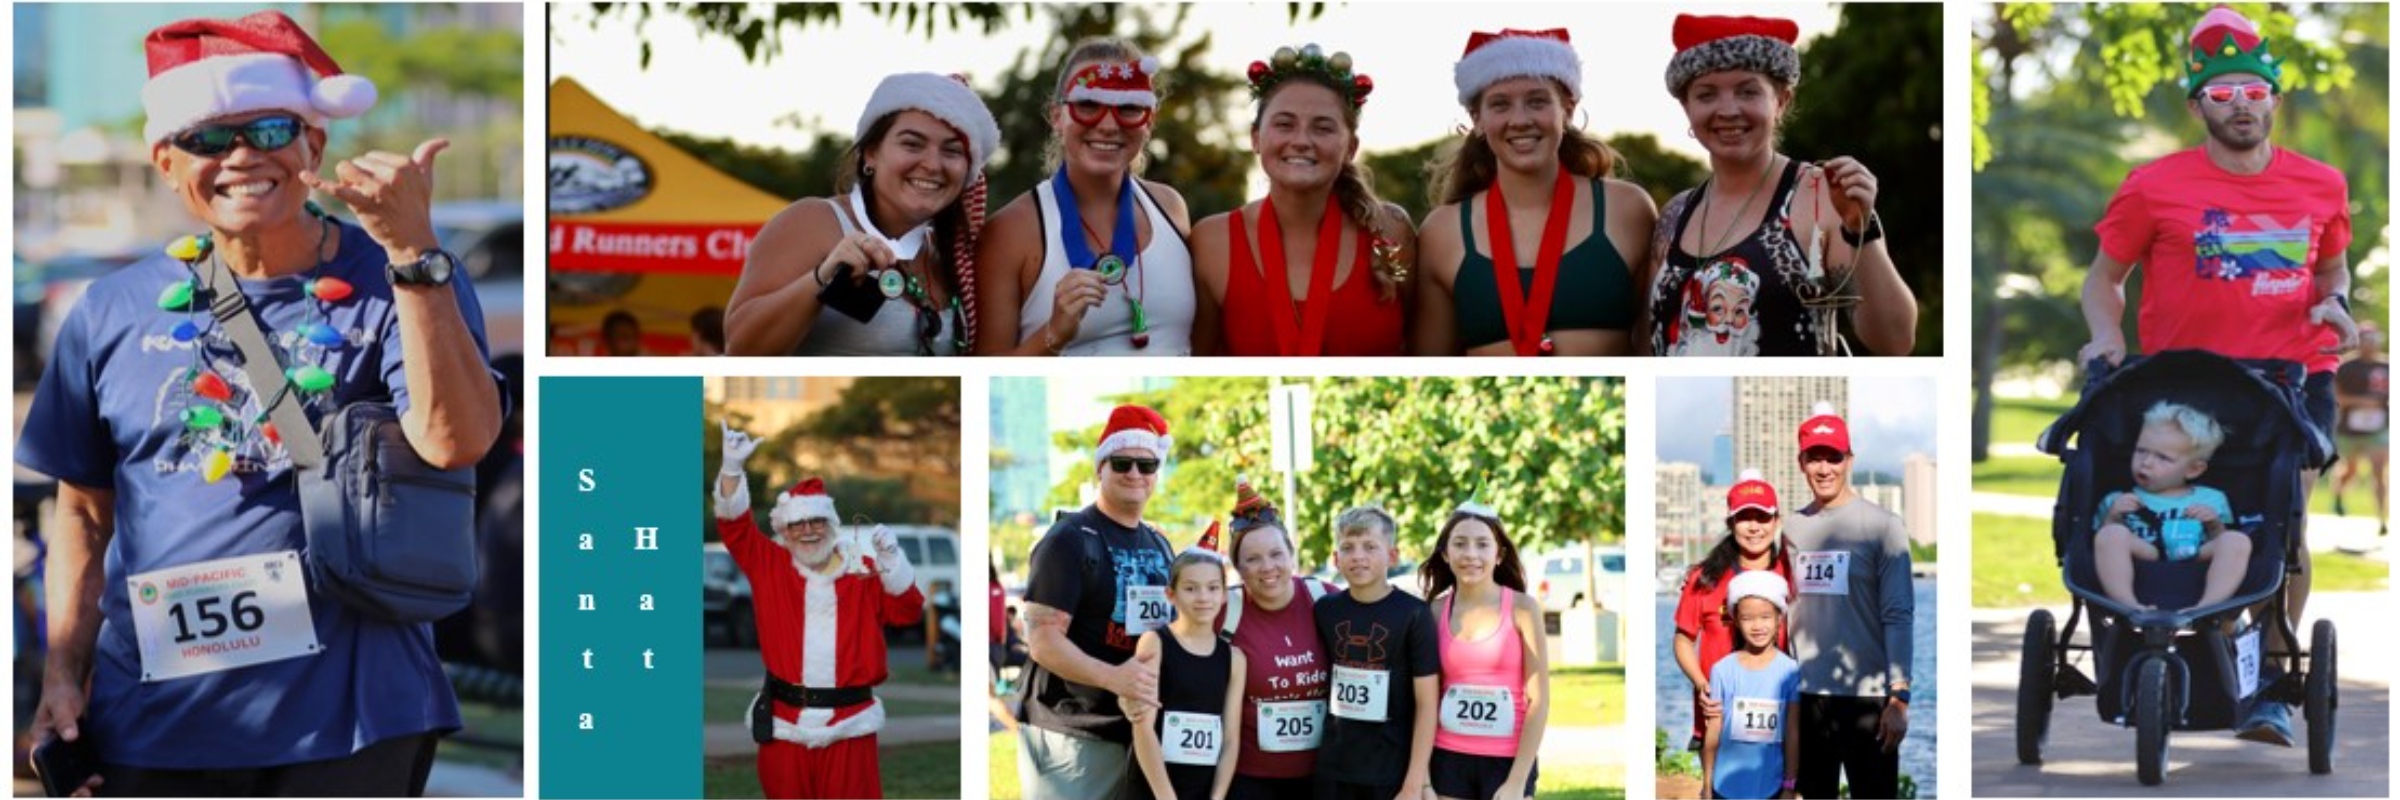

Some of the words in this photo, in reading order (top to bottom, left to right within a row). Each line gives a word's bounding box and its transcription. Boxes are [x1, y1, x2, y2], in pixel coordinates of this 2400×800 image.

[573, 226, 698, 257] Runners
[166, 567, 246, 590] MID-PACIFIC
[1805, 563, 1835, 581] 114
[168, 590, 265, 644] 156
[181, 636, 261, 659] HONOLULU
[1284, 634, 1293, 648] I
[1273, 650, 1315, 668] Want
[1267, 676, 1290, 690] To
[1295, 669, 1328, 687] Ride
[1337, 682, 1370, 706] 203
[1456, 699, 1498, 722] 202
[1744, 711, 1778, 731] 110
[1275, 716, 1314, 737] 205
[1180, 727, 1214, 750] 201
